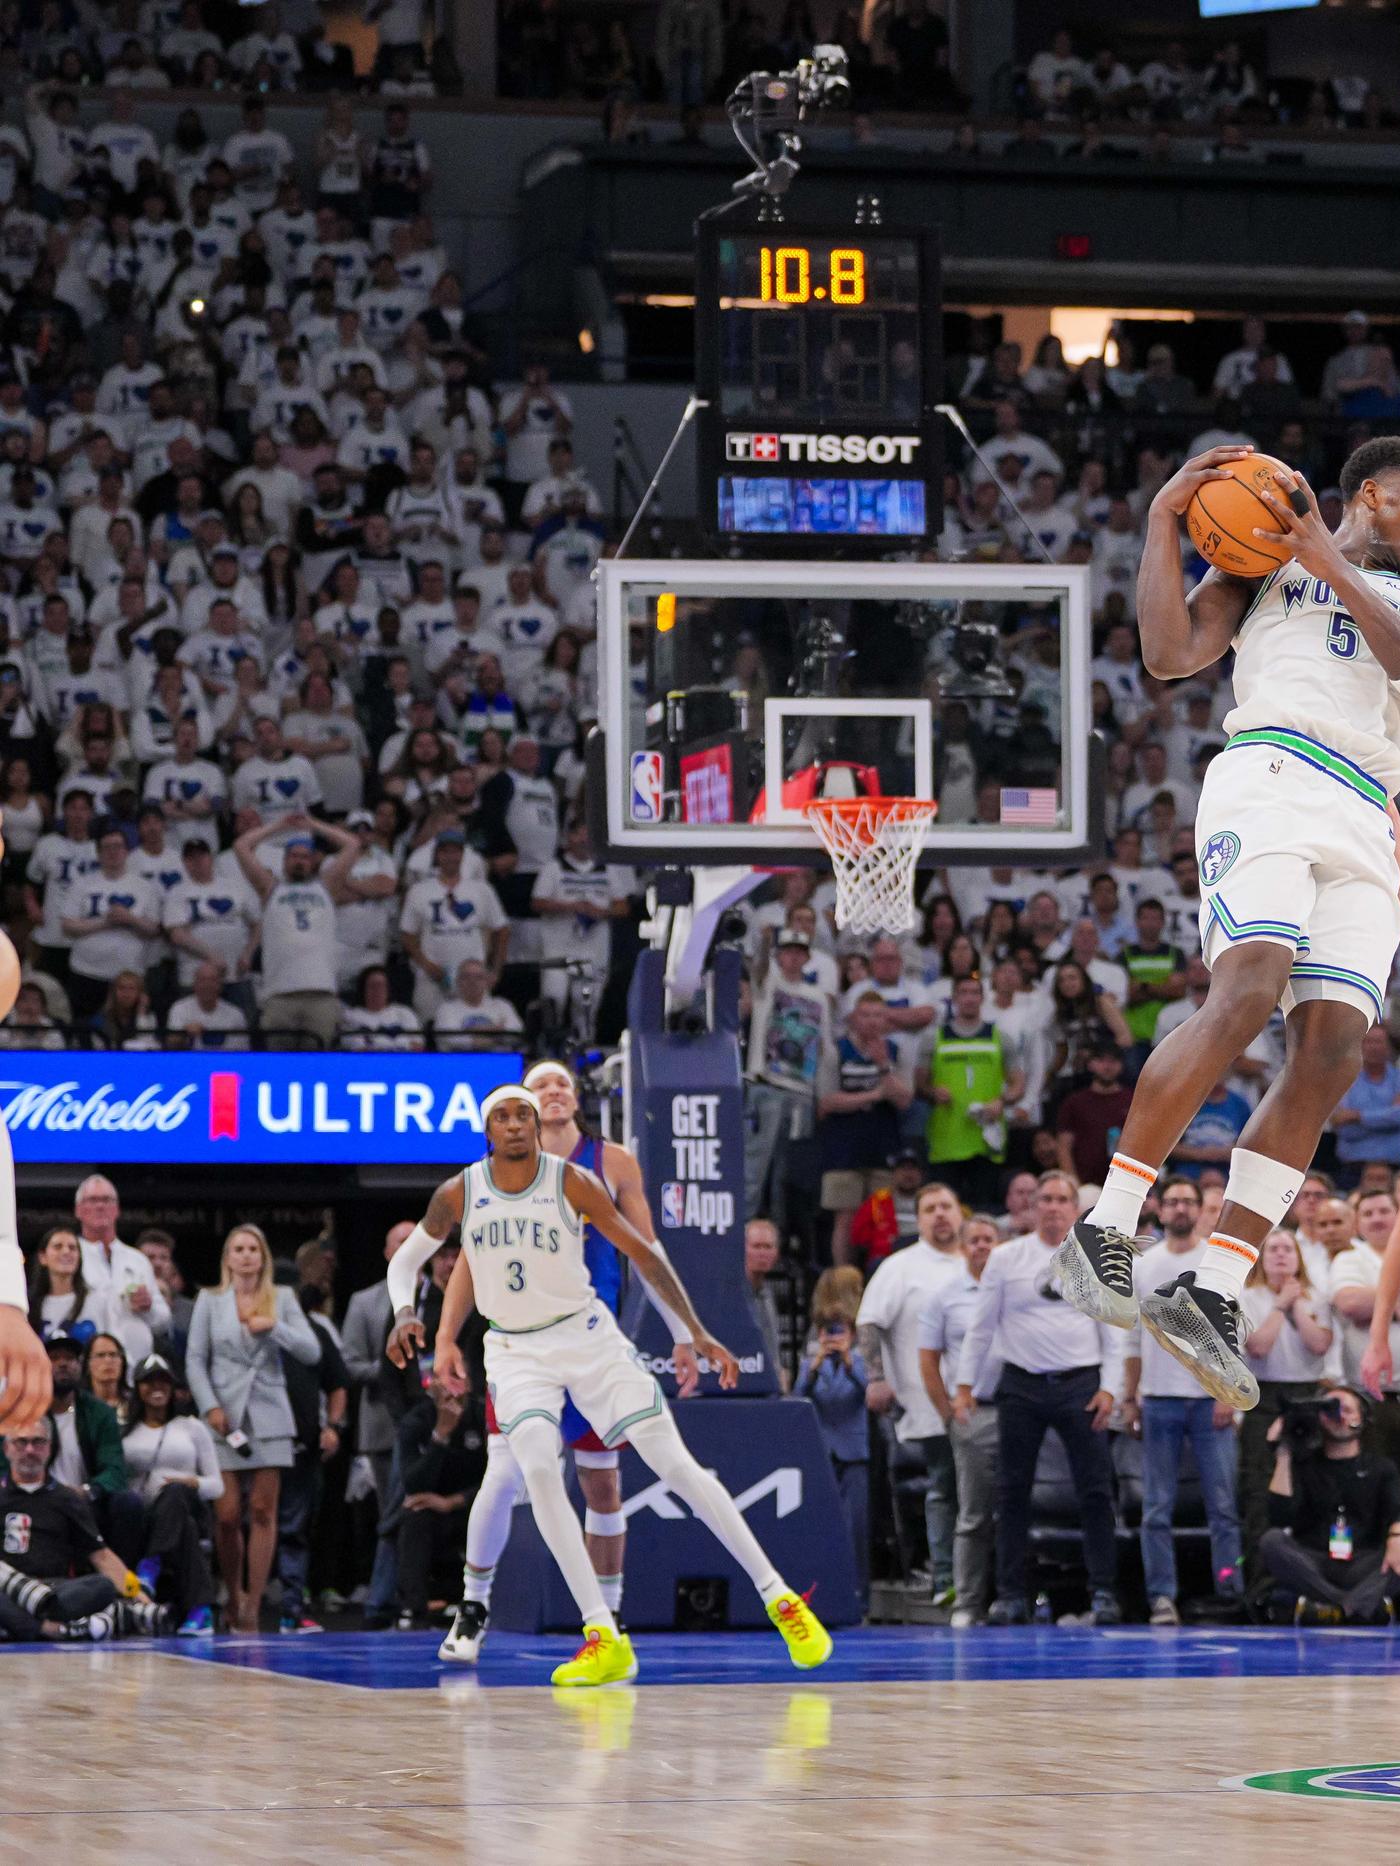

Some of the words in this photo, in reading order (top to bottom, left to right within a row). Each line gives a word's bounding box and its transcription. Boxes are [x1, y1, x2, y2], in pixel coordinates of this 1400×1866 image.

[760, 247, 866, 304] 10.8
[779, 434, 921, 464] TISSOT
[1326, 611, 1359, 661] 5
[88, 894, 103, 917] I
[431, 901, 444, 924] I
[0, 1081, 198, 1132] Michelob
[256, 1081, 484, 1133] ULTRA
[671, 1094, 721, 1137] GET
[671, 1138, 722, 1181] THE
[684, 1182, 735, 1236] App
[1281, 1189, 1295, 1205] 5
[470, 1216, 561, 1255] WOLVES
[505, 1259, 525, 1293] 3
